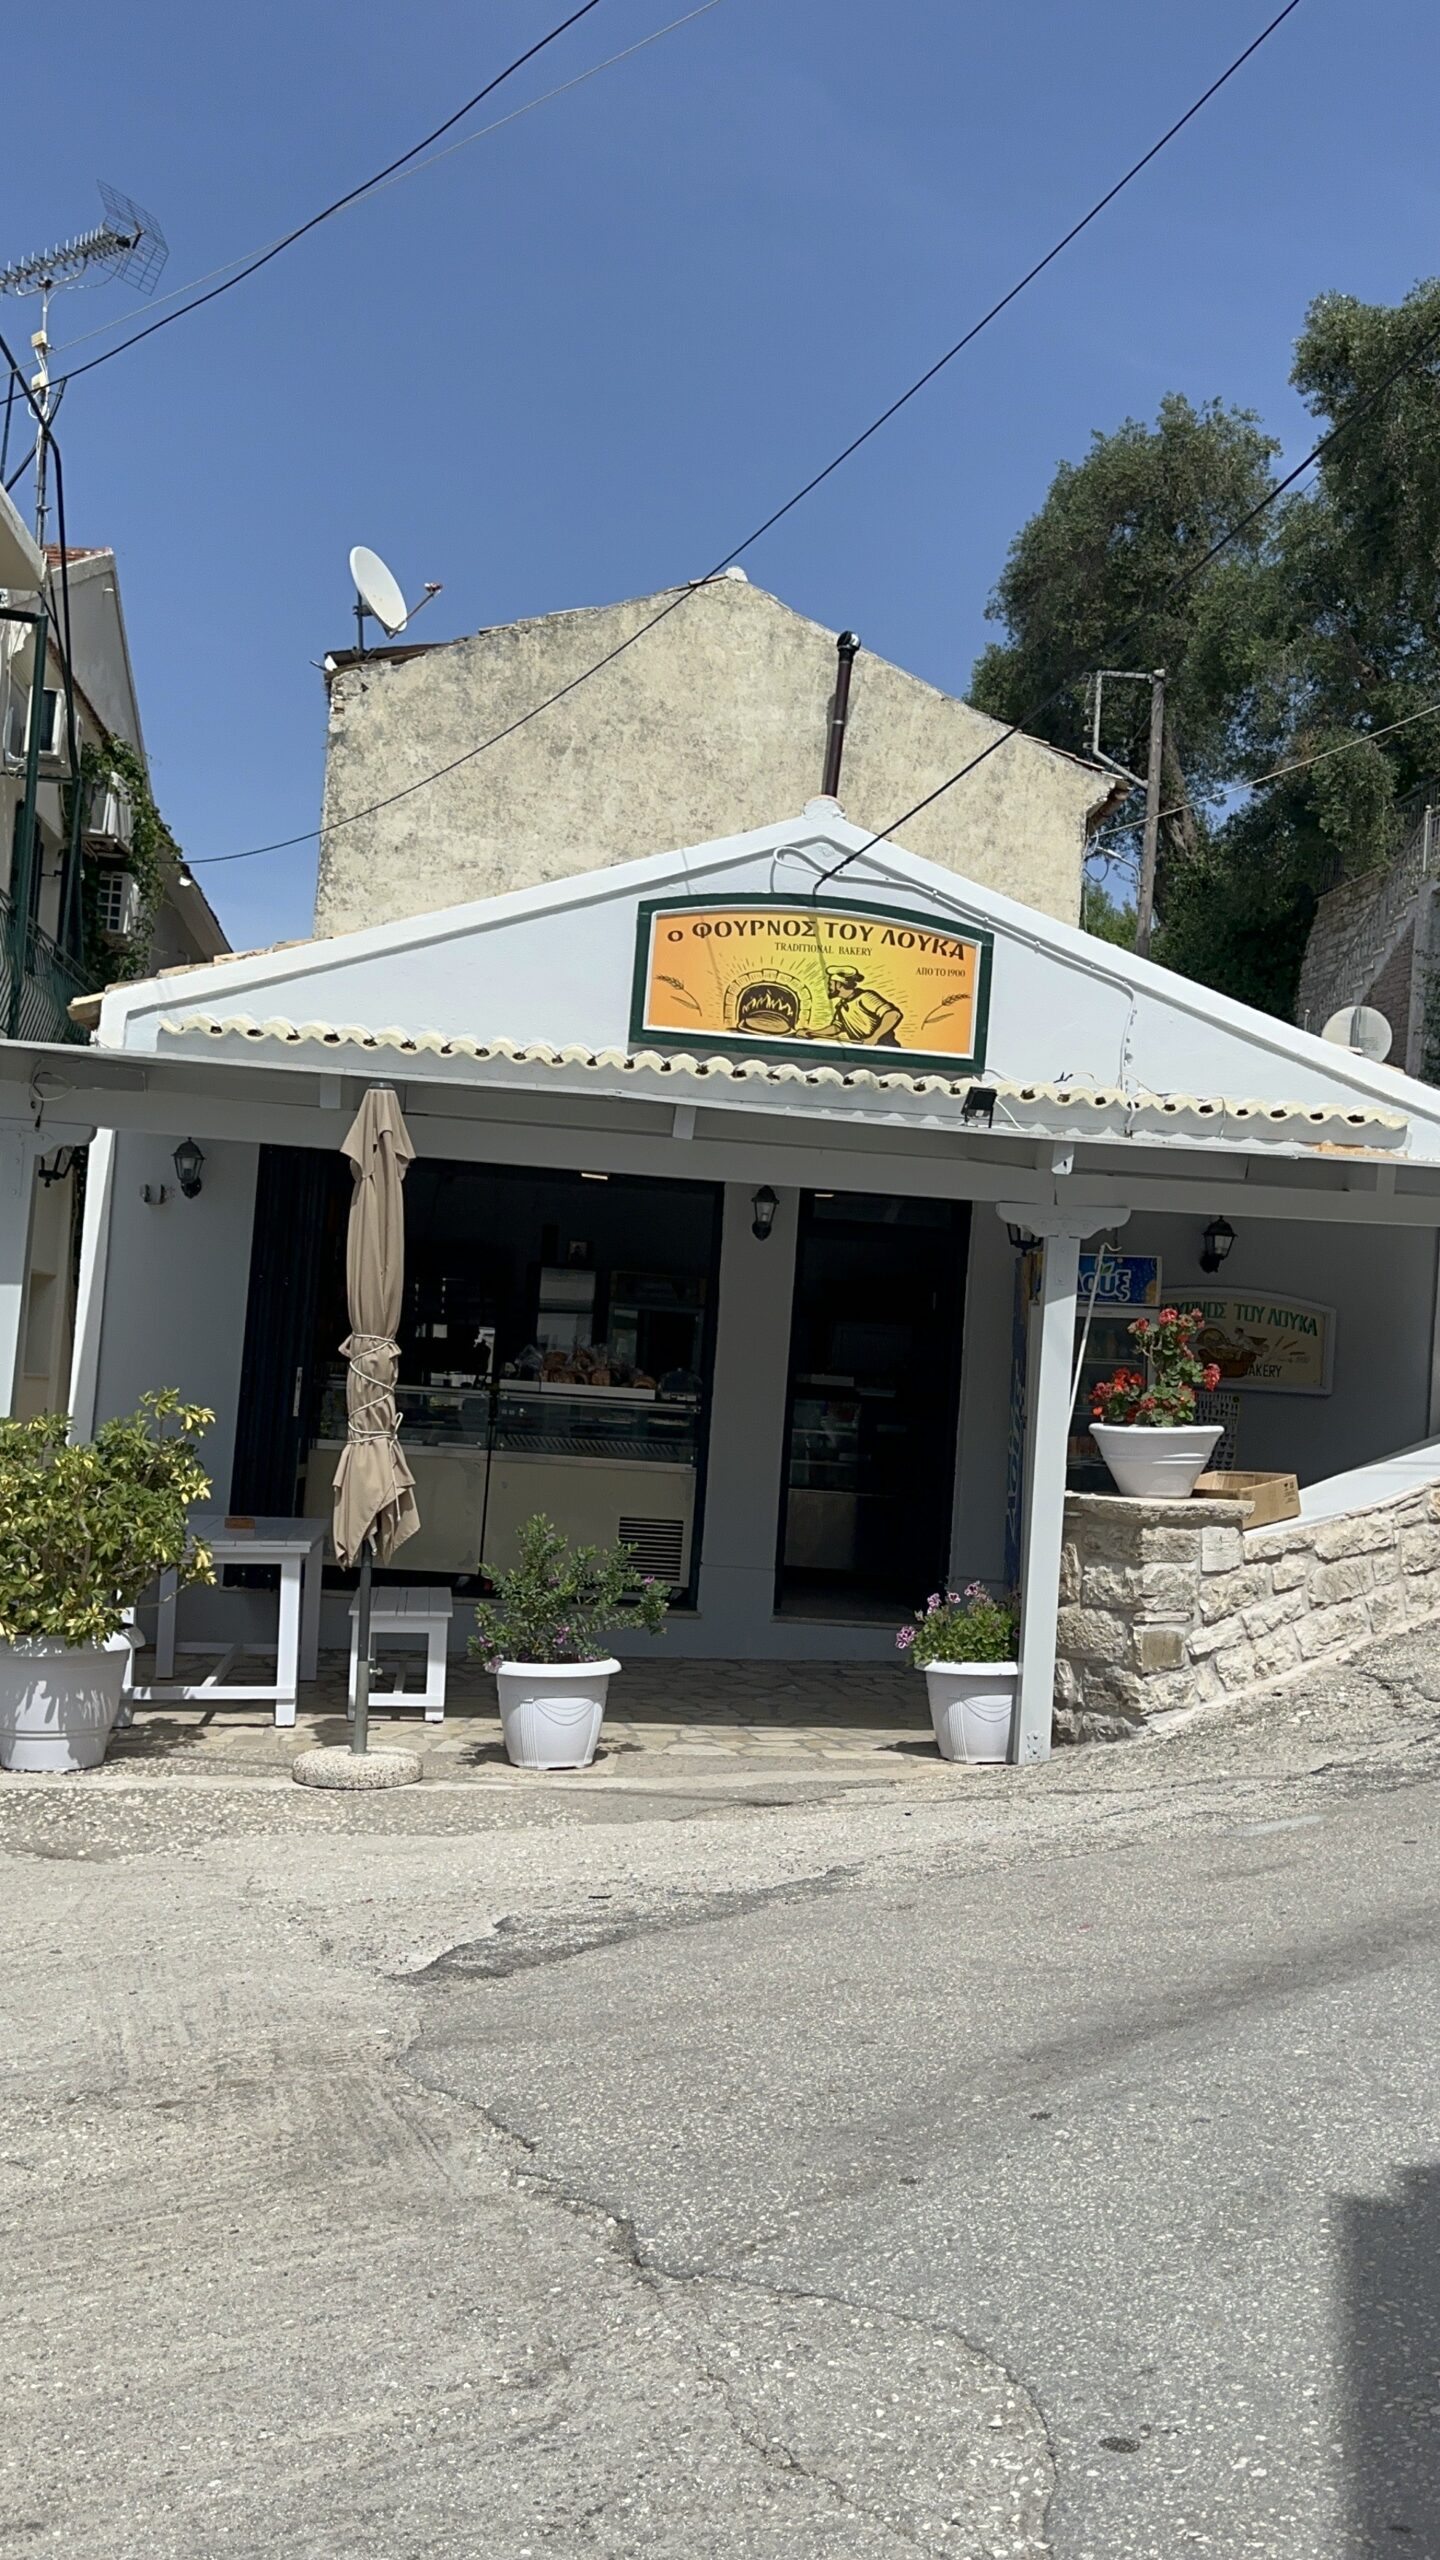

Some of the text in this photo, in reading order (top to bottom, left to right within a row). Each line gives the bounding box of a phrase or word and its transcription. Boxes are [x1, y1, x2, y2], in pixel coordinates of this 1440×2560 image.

[667, 918, 965, 961] Ο ΦΟΥΡΝΟΣ ΤΟΥ ΛΟΥΚΑ
[774, 942, 873, 957] TRADITIONAL BAKERY
[915, 967, 966, 977] ΑΠΟ ΤΟ 1900
[1233, 1302, 1266, 1323] ΤΟΥ
[1267, 1308, 1319, 1337] ΛΟΥΚΑ
